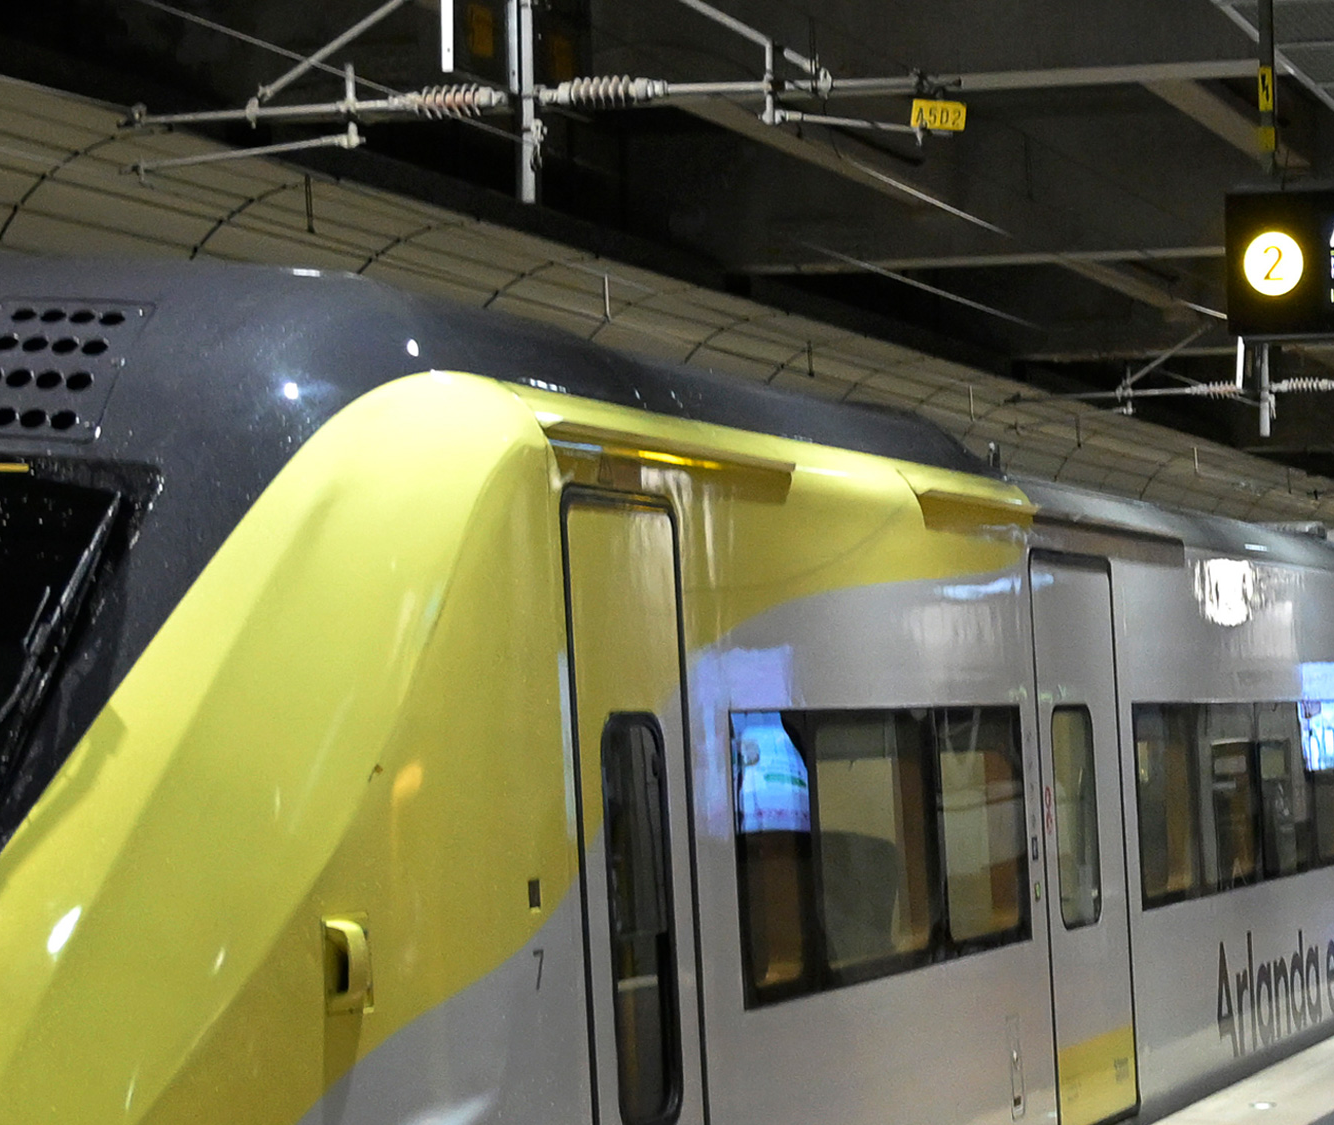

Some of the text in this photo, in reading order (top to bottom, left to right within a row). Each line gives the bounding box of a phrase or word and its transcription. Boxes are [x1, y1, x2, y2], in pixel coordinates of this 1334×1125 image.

[1263, 245, 1284, 281] 2
[532, 949, 544, 991] 7
[1217, 928, 1323, 1058] Arlanda
